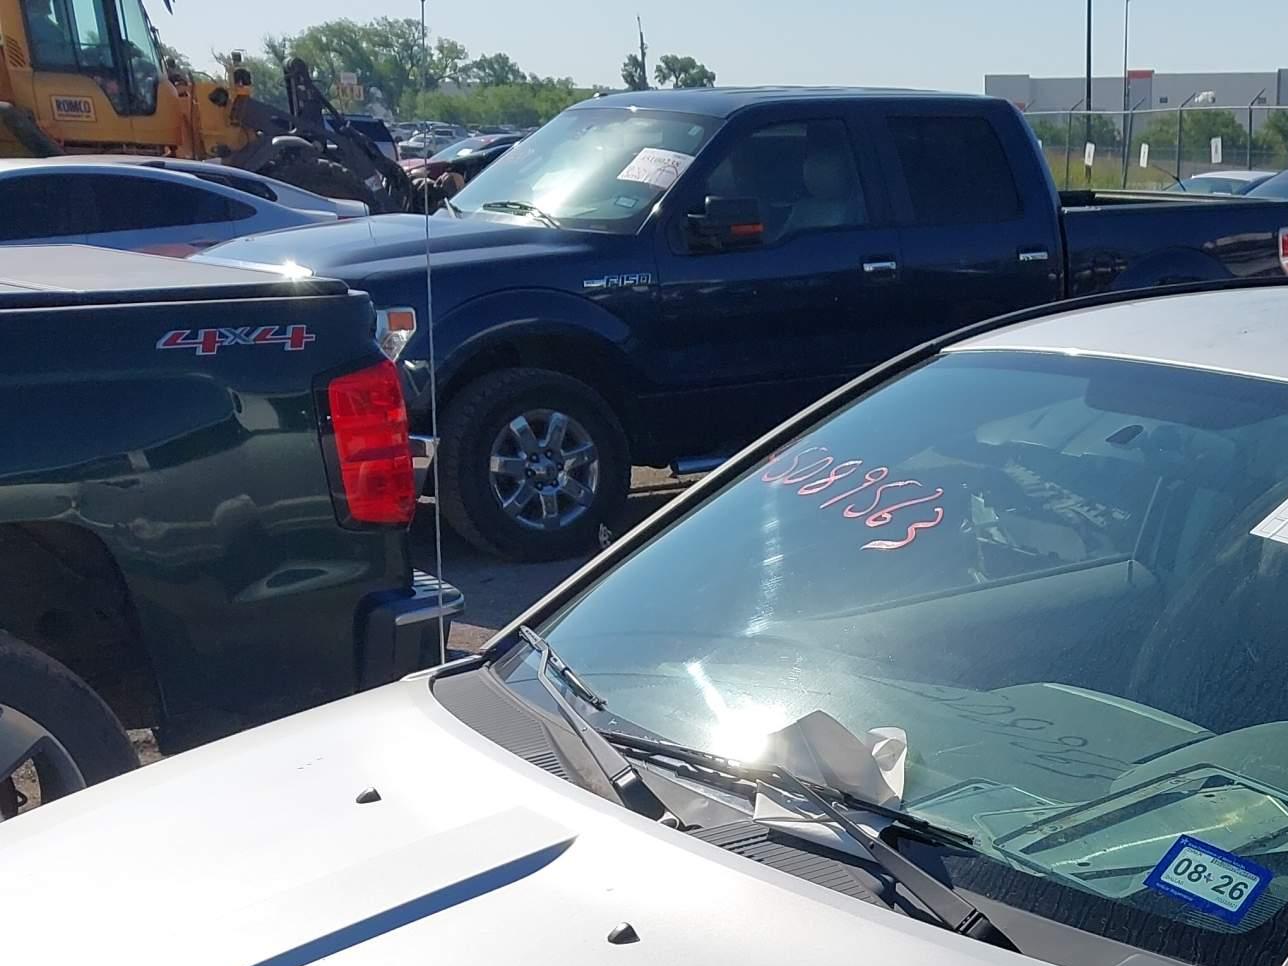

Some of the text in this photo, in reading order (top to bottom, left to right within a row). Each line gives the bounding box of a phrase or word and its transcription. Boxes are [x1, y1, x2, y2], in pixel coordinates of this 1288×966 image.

[763, 446, 945, 551] 5089563
[1173, 858, 1207, 883] 08
[1211, 874, 1249, 901] 26
